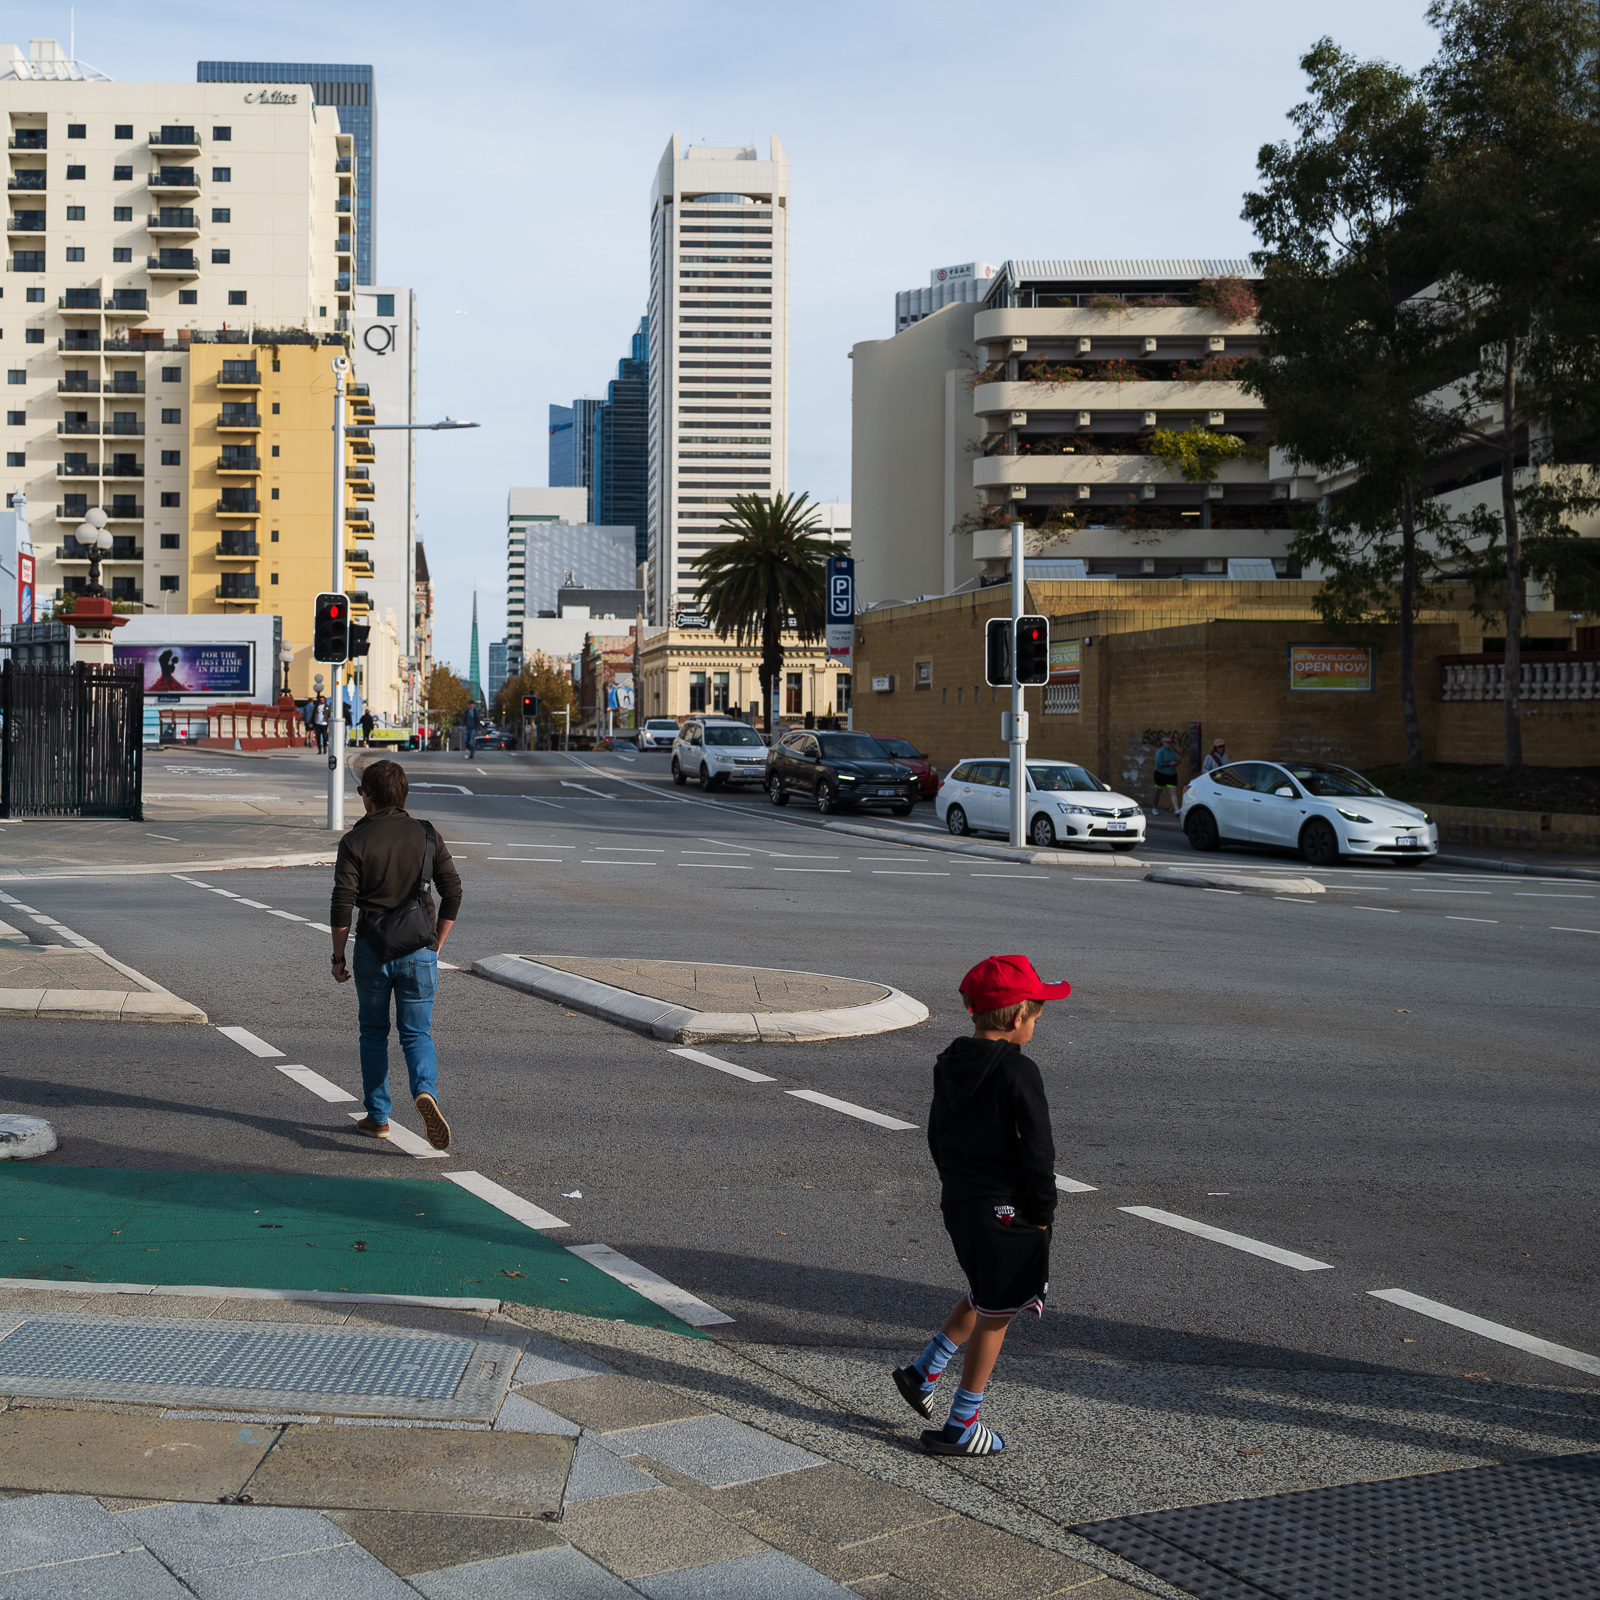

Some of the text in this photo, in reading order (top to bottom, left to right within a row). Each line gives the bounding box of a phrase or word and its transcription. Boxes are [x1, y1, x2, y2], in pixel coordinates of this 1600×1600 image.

[364, 324, 398, 356] QT
[836, 579, 848, 594] P
[201, 651, 237, 659] FOR THE
[196, 658, 243, 666] FIRST TIME
[198, 665, 239, 673] IN PERTH!
[1294, 662, 1368, 672] OPEN NOW
